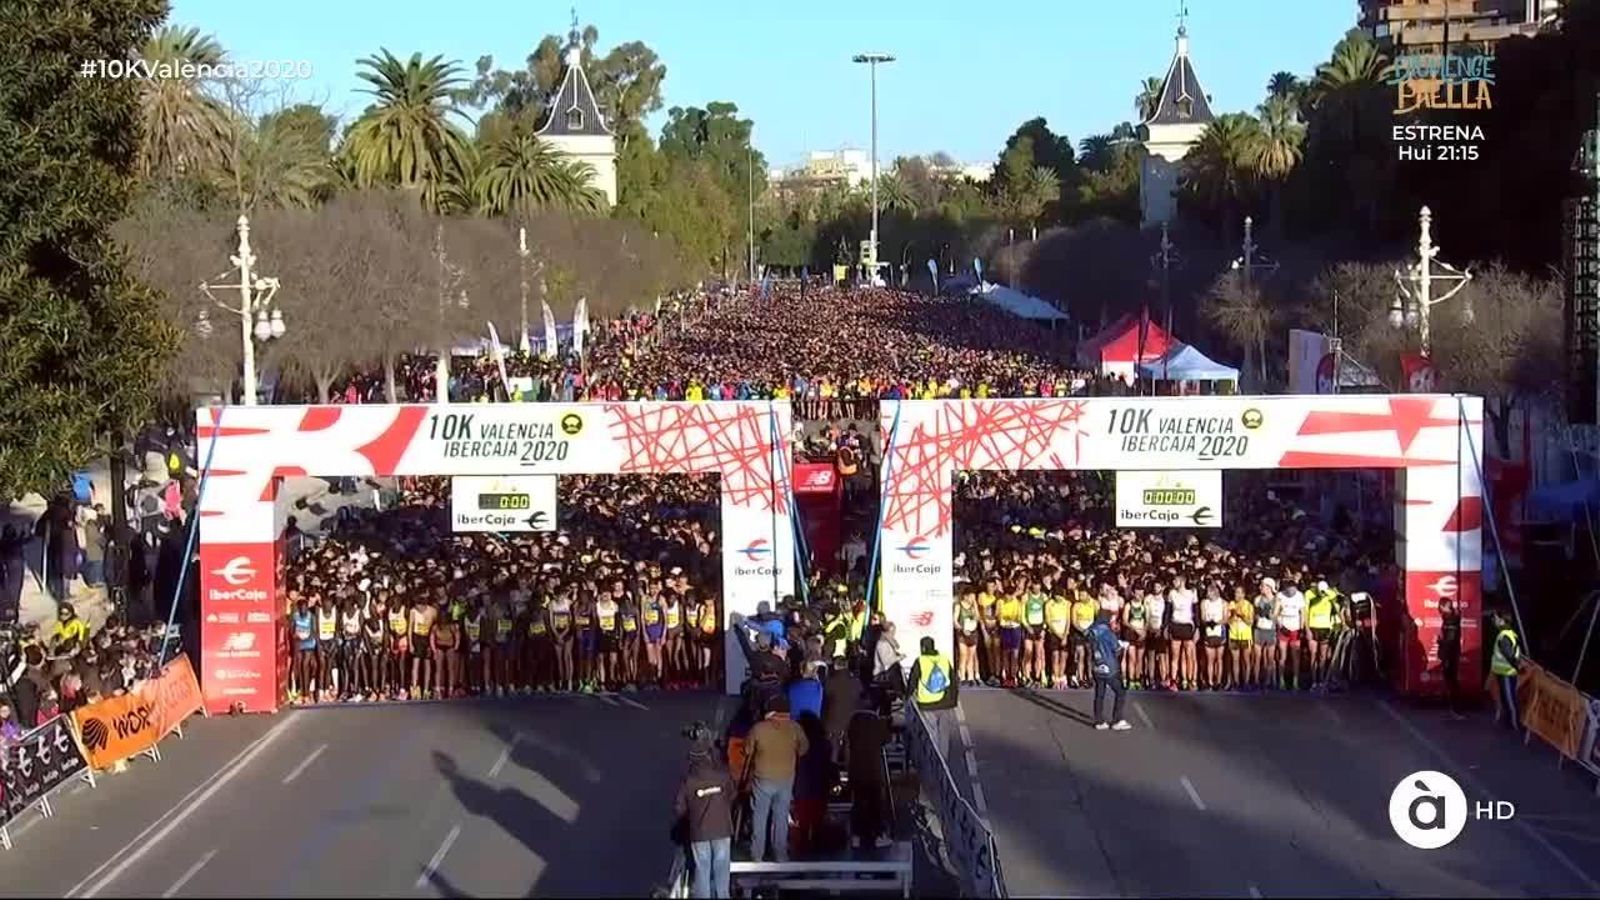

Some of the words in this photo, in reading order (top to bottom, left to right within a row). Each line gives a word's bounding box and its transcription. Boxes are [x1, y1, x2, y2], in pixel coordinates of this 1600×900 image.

[430, 413, 475, 440] 10K
[480, 423, 554, 440] VALENCIA
[1107, 408, 1153, 434] 10K
[1159, 417, 1234, 434] VALENCIA
[444, 440, 519, 457] IBERCAJA
[519, 440, 570, 464] 2020
[1121, 435, 1197, 452] IBERCAJA
[1197, 435, 1250, 459] 2020
